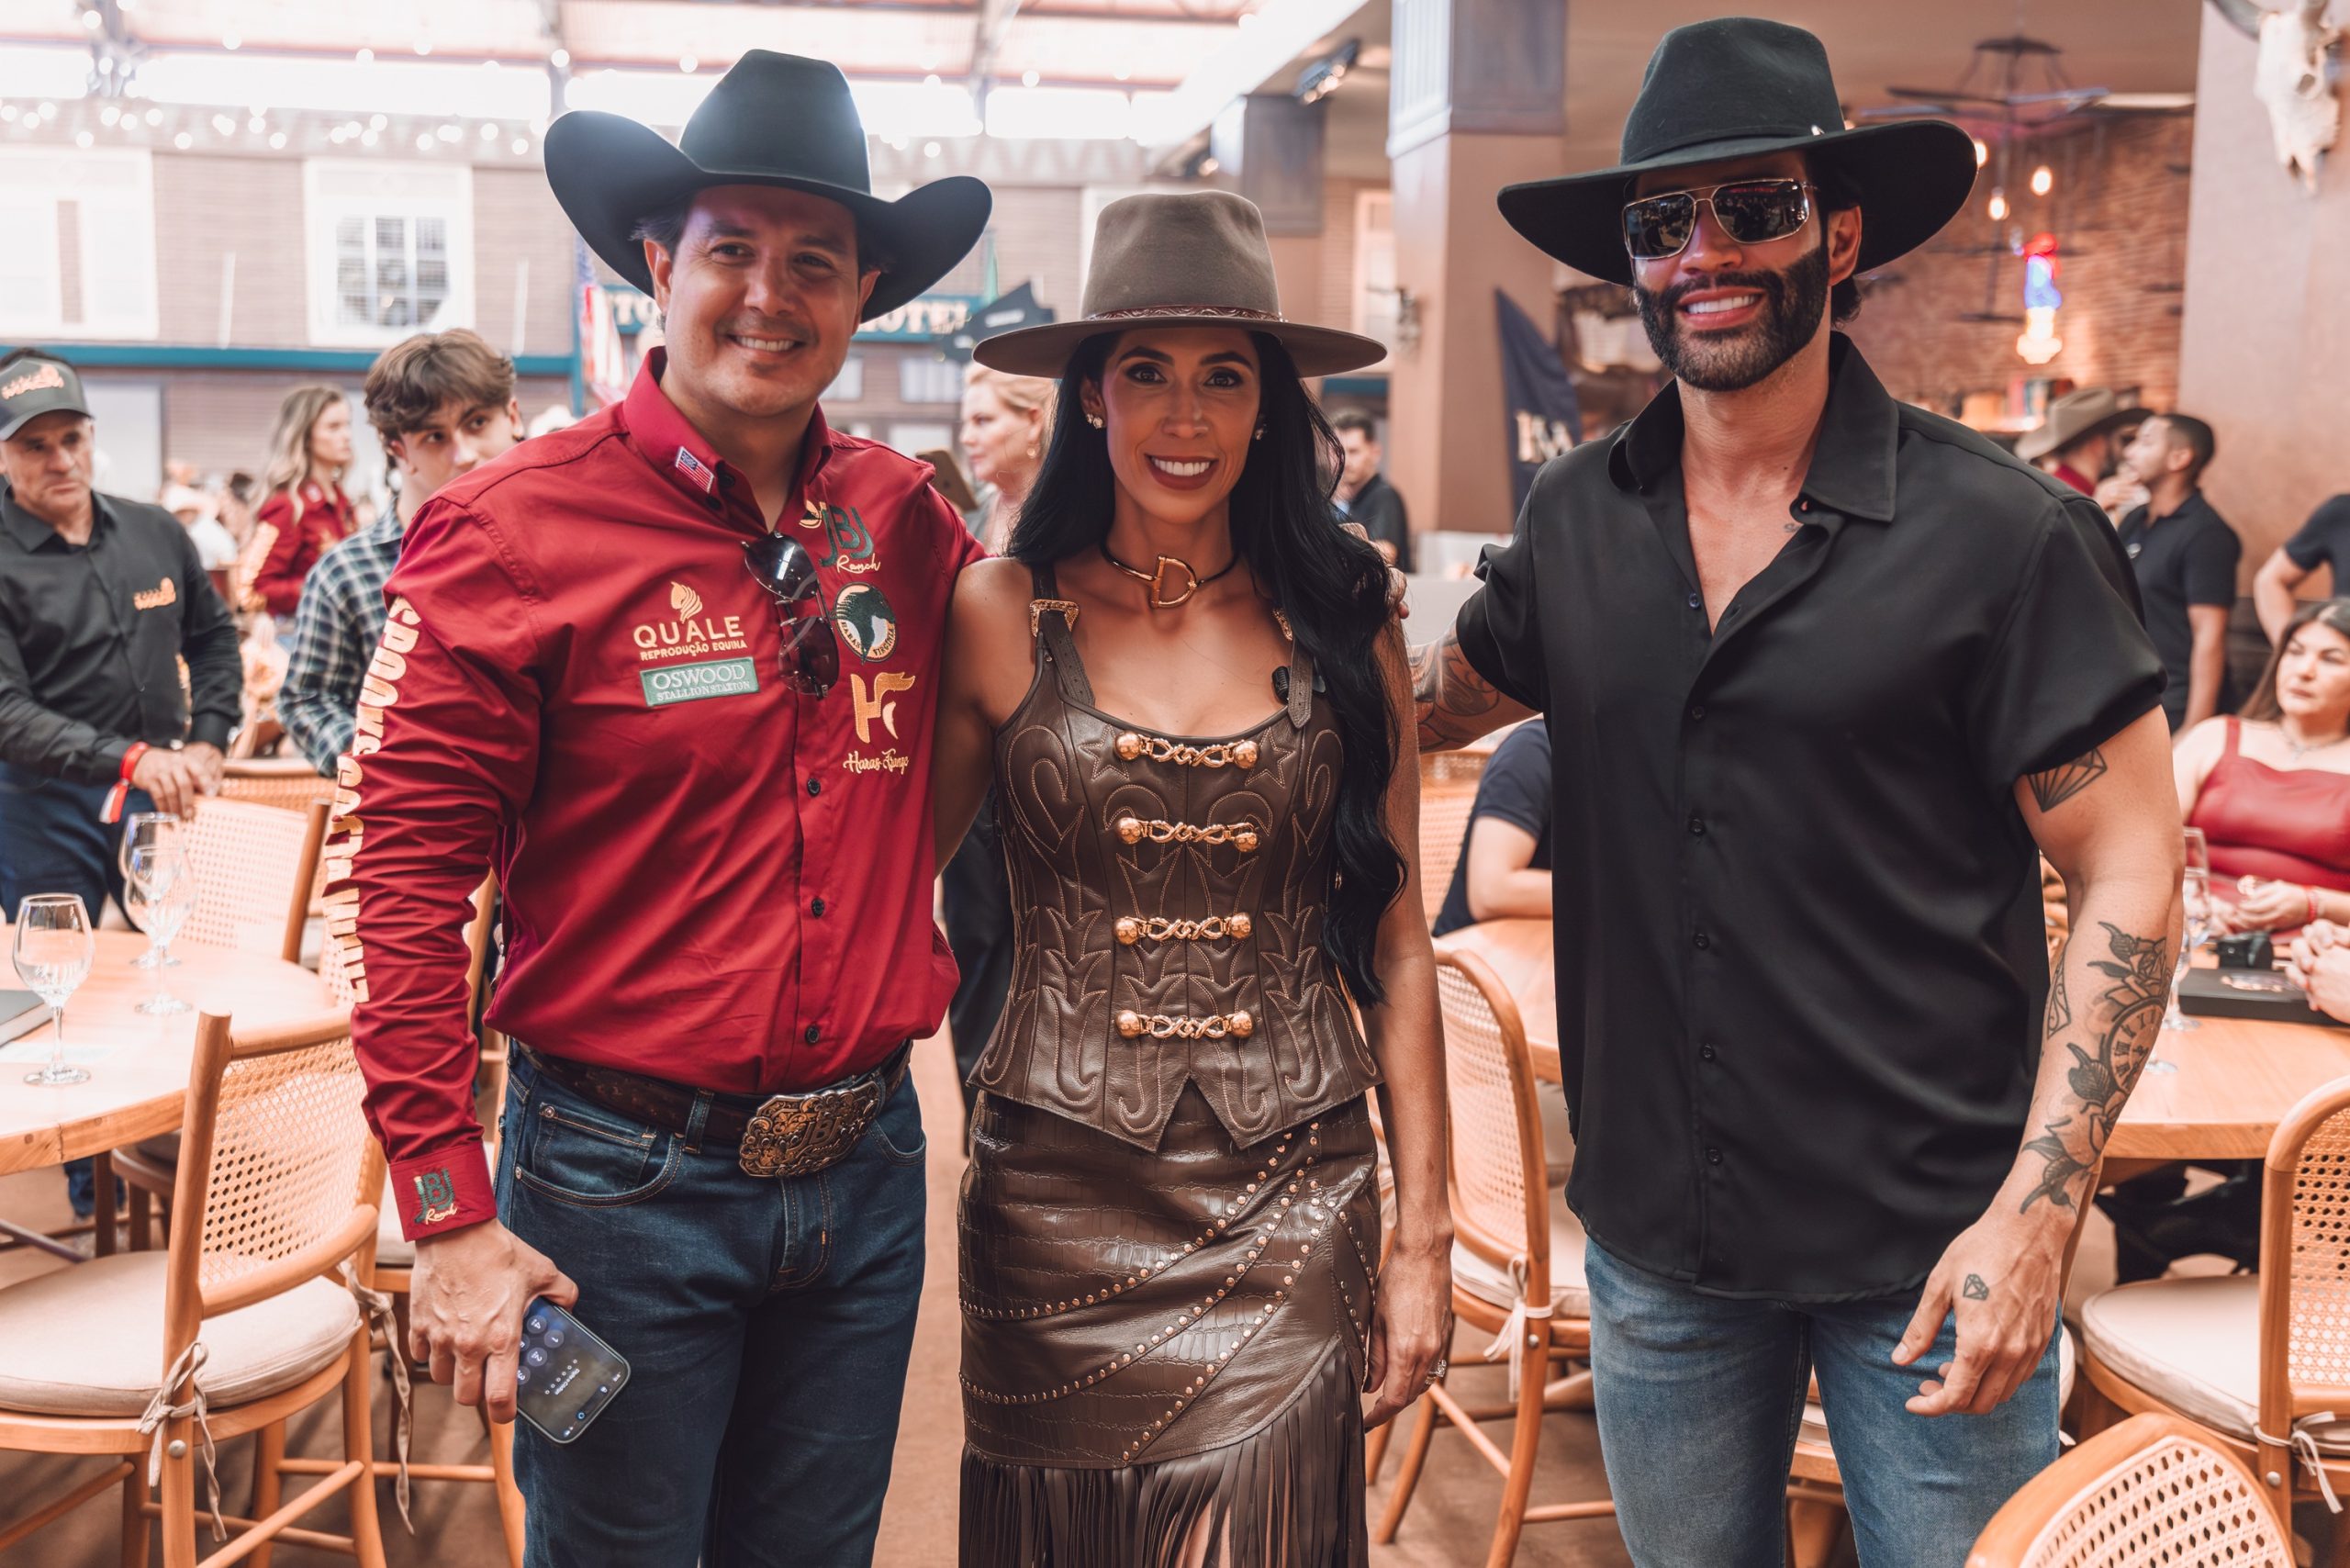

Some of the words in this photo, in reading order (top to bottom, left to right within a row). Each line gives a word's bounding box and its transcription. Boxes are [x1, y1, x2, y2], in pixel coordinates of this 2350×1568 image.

[836, 553, 881, 574] Ranch
[633, 615, 744, 648] QUALE
[640, 640, 710, 661] REPRODUÇÃO
[712, 640, 748, 652] EQUINA
[652, 664, 746, 690] OSWOOD
[843, 750, 882, 774] Haras
